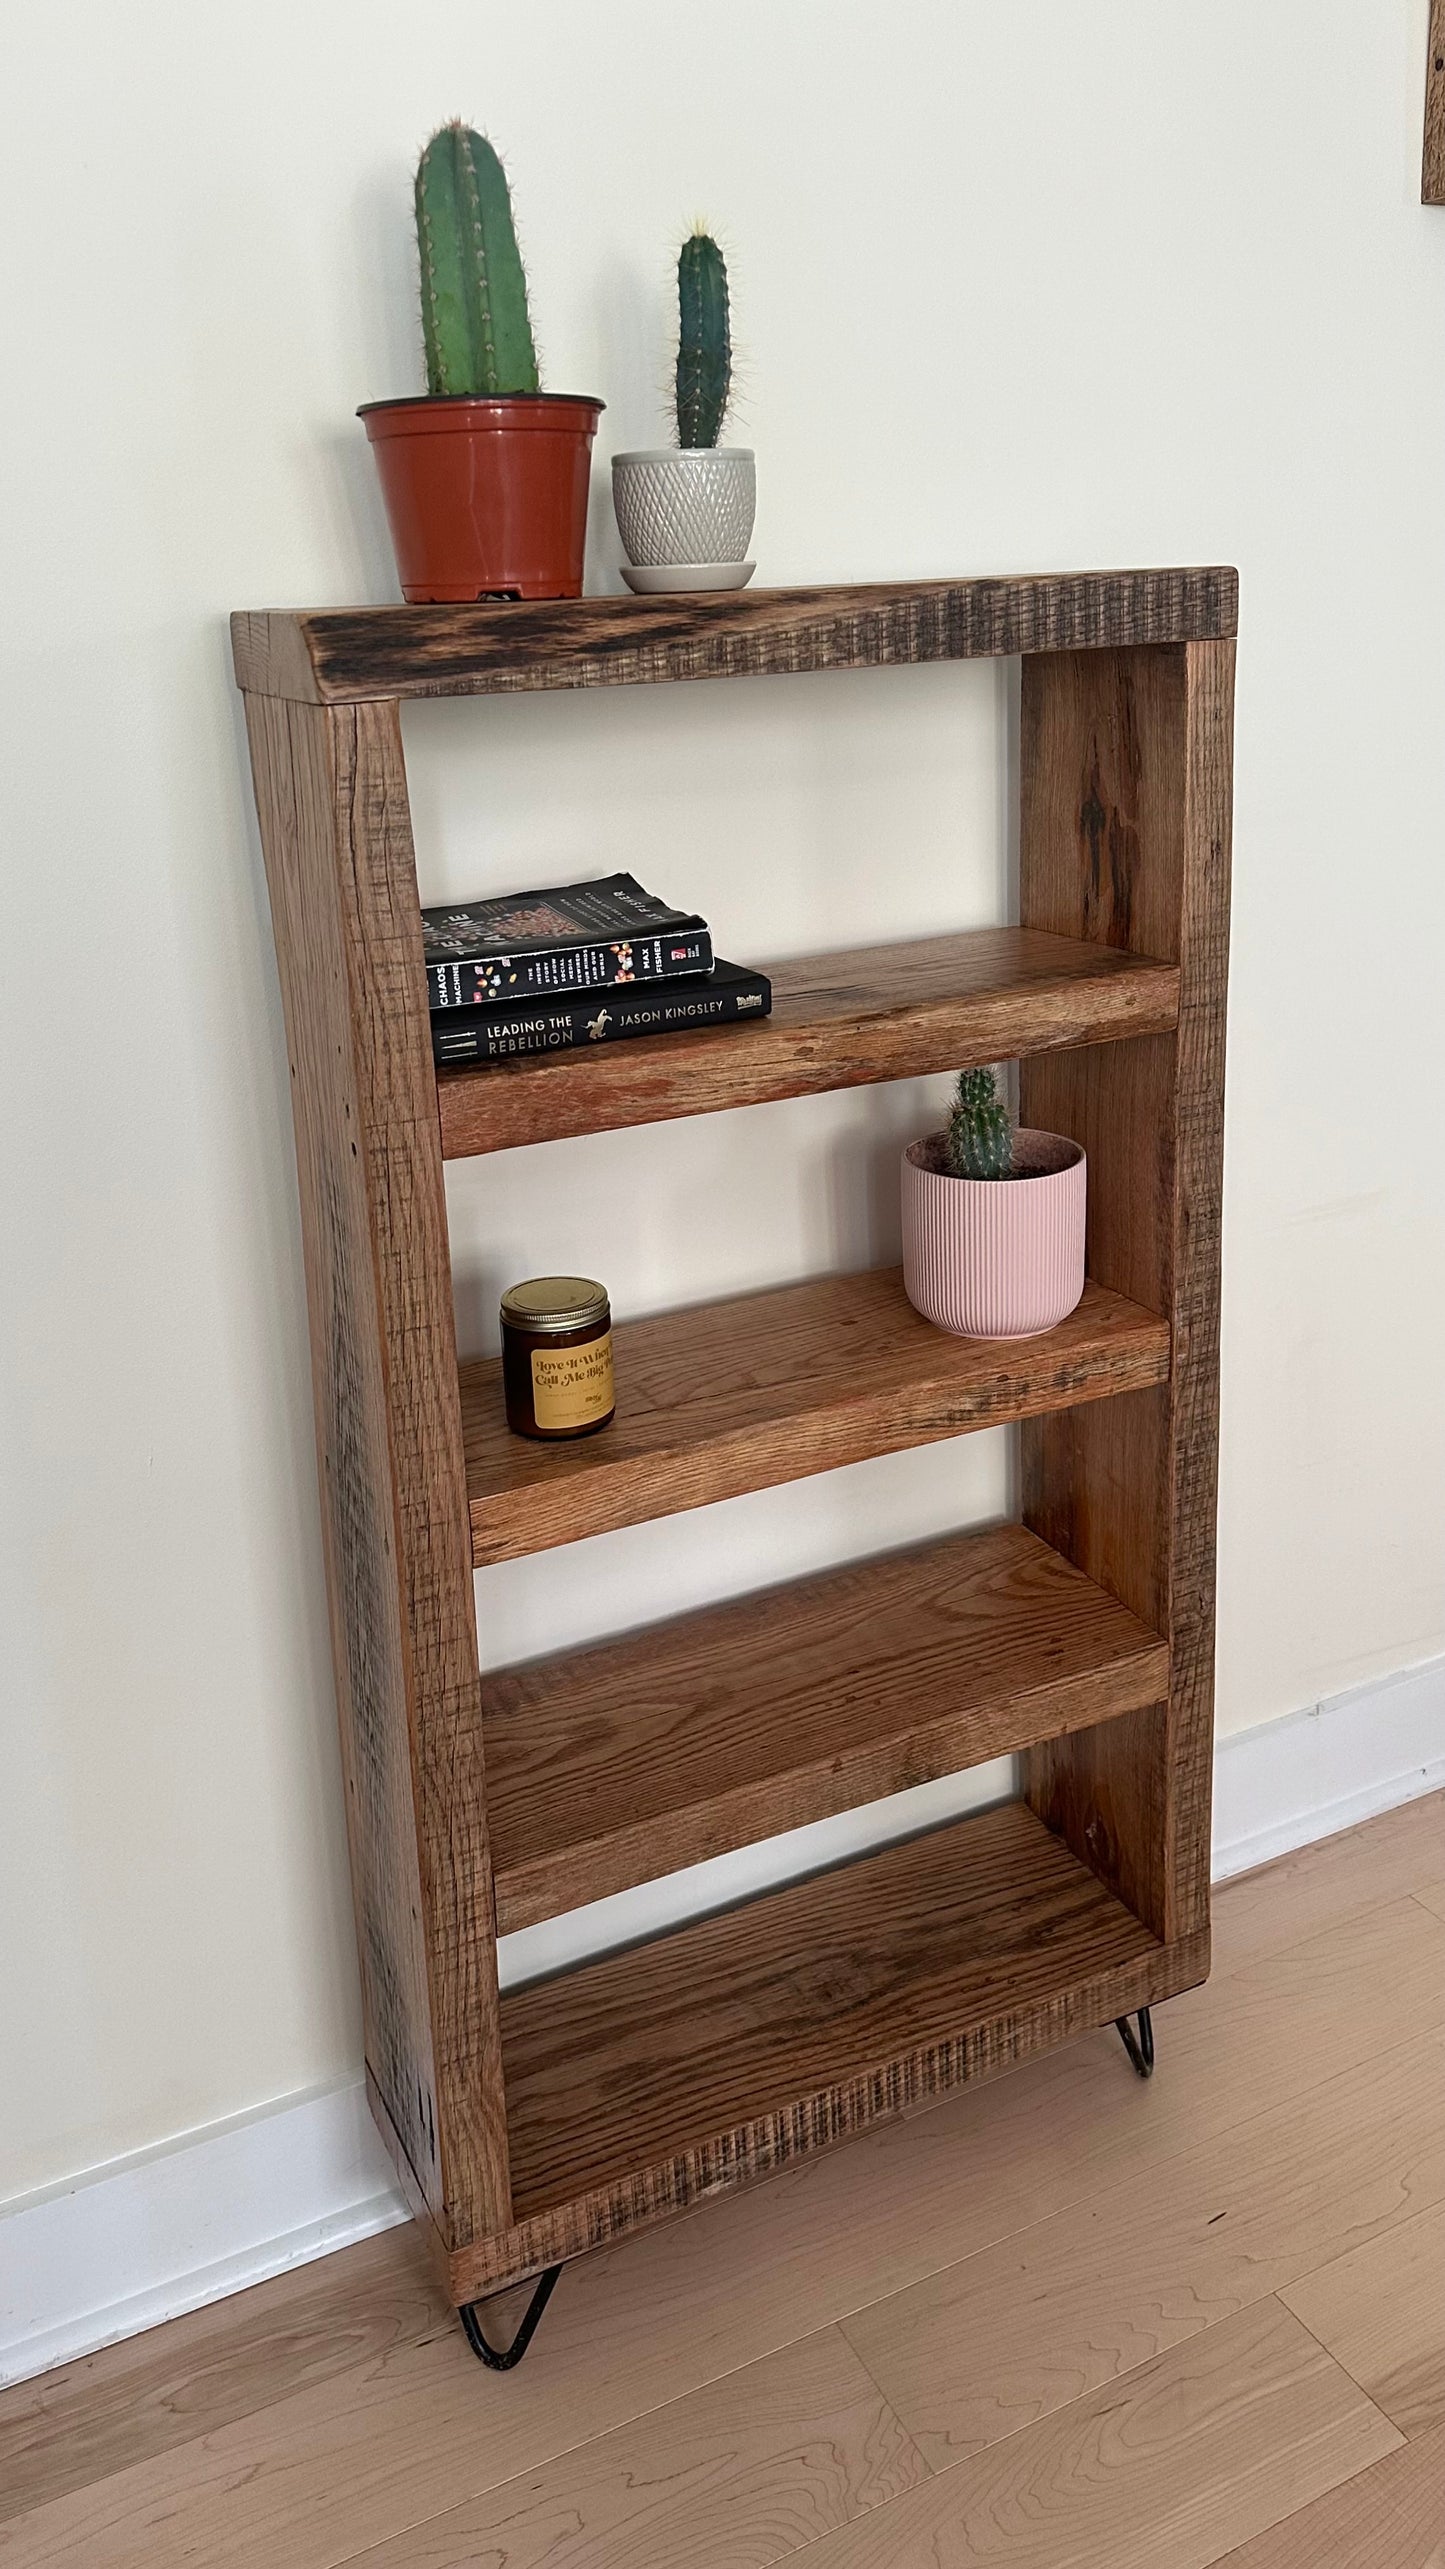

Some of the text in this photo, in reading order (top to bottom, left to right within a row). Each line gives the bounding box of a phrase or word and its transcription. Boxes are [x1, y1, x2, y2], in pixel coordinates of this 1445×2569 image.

[642, 948, 650, 969] MAX
[654, 940, 663, 973] FISHER
[437, 966, 449, 1006] CHAOS
[453, 964, 462, 1004] MACHINE
[553, 975, 558, 985] OF
[619, 1010, 661, 1027] JASON
[665, 1000, 723, 1020] KINGSLEY
[487, 1015, 572, 1038] LEADING THE
[488, 1030, 573, 1055] REBELLION
[536, 1361, 564, 1374] Love
[566, 1359, 578, 1369] It
[535, 1375, 558, 1389] Call
[561, 1371, 585, 1387] Me
